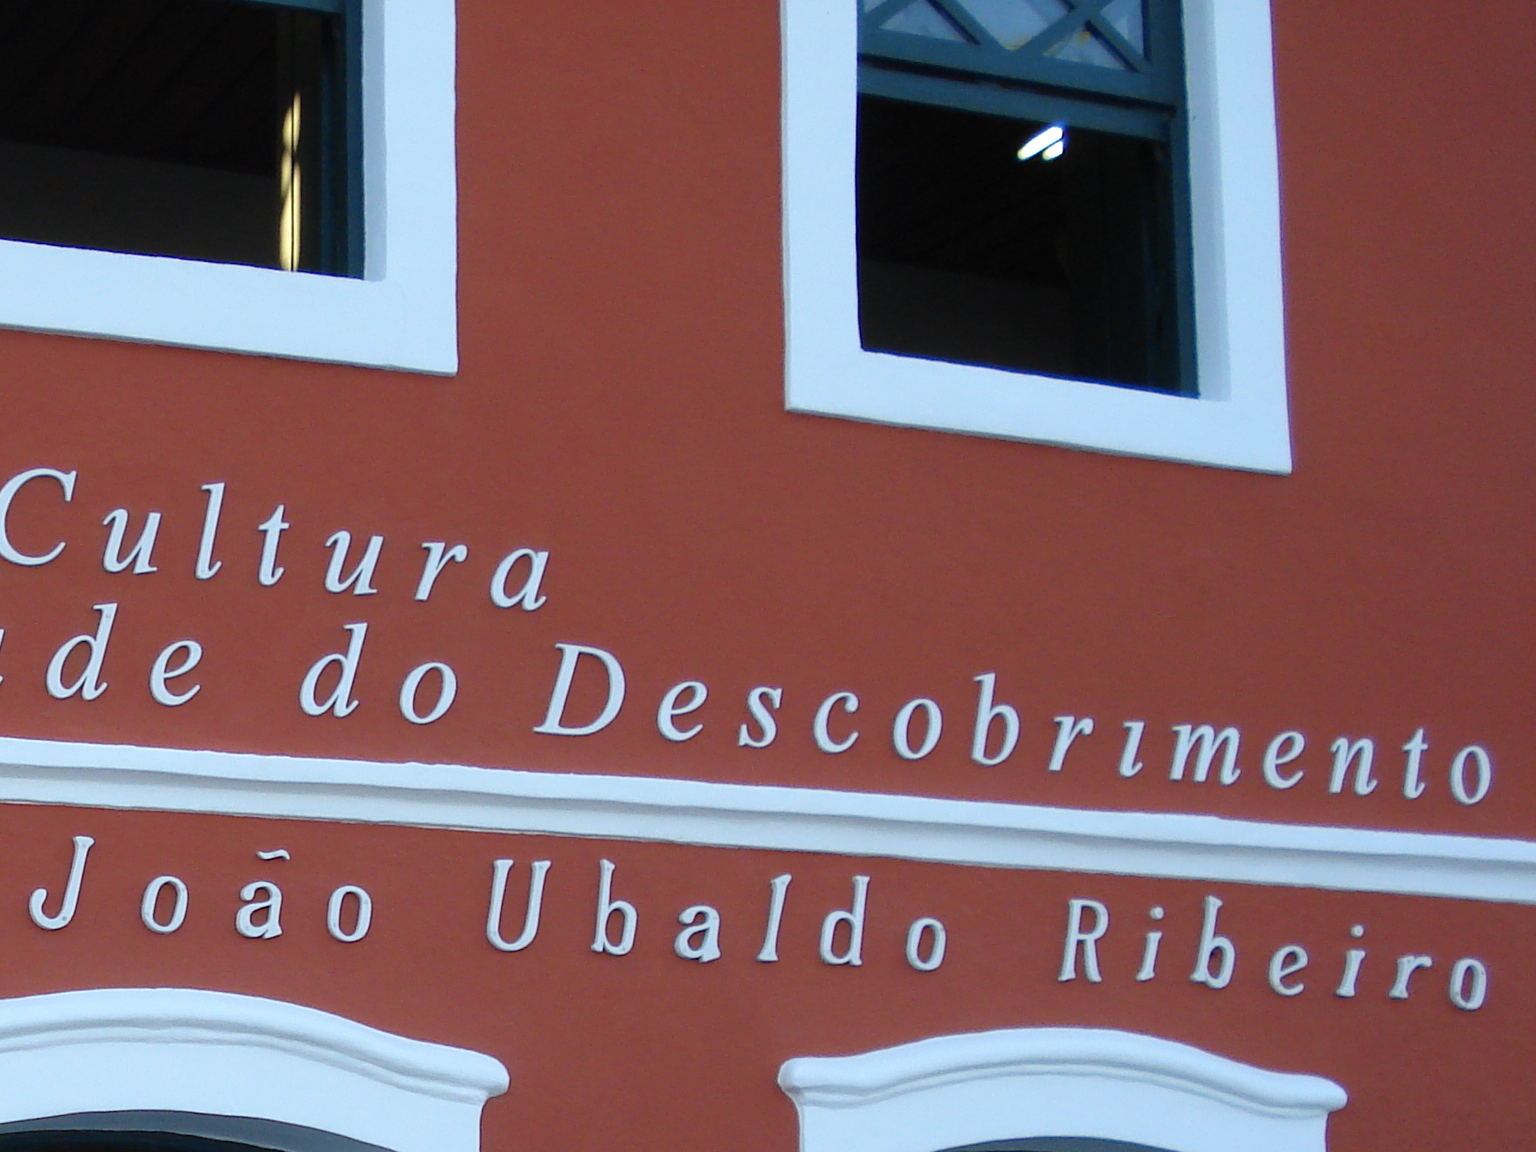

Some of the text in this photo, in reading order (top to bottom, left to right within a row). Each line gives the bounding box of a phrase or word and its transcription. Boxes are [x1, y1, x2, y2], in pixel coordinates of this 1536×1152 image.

[298, 621, 459, 726] do
[530, 641, 1493, 807] Descobrimento
[27, 834, 374, 944] João
[485, 857, 948, 973] Ubaldo
[1056, 894, 1489, 1011] Ribeiro
